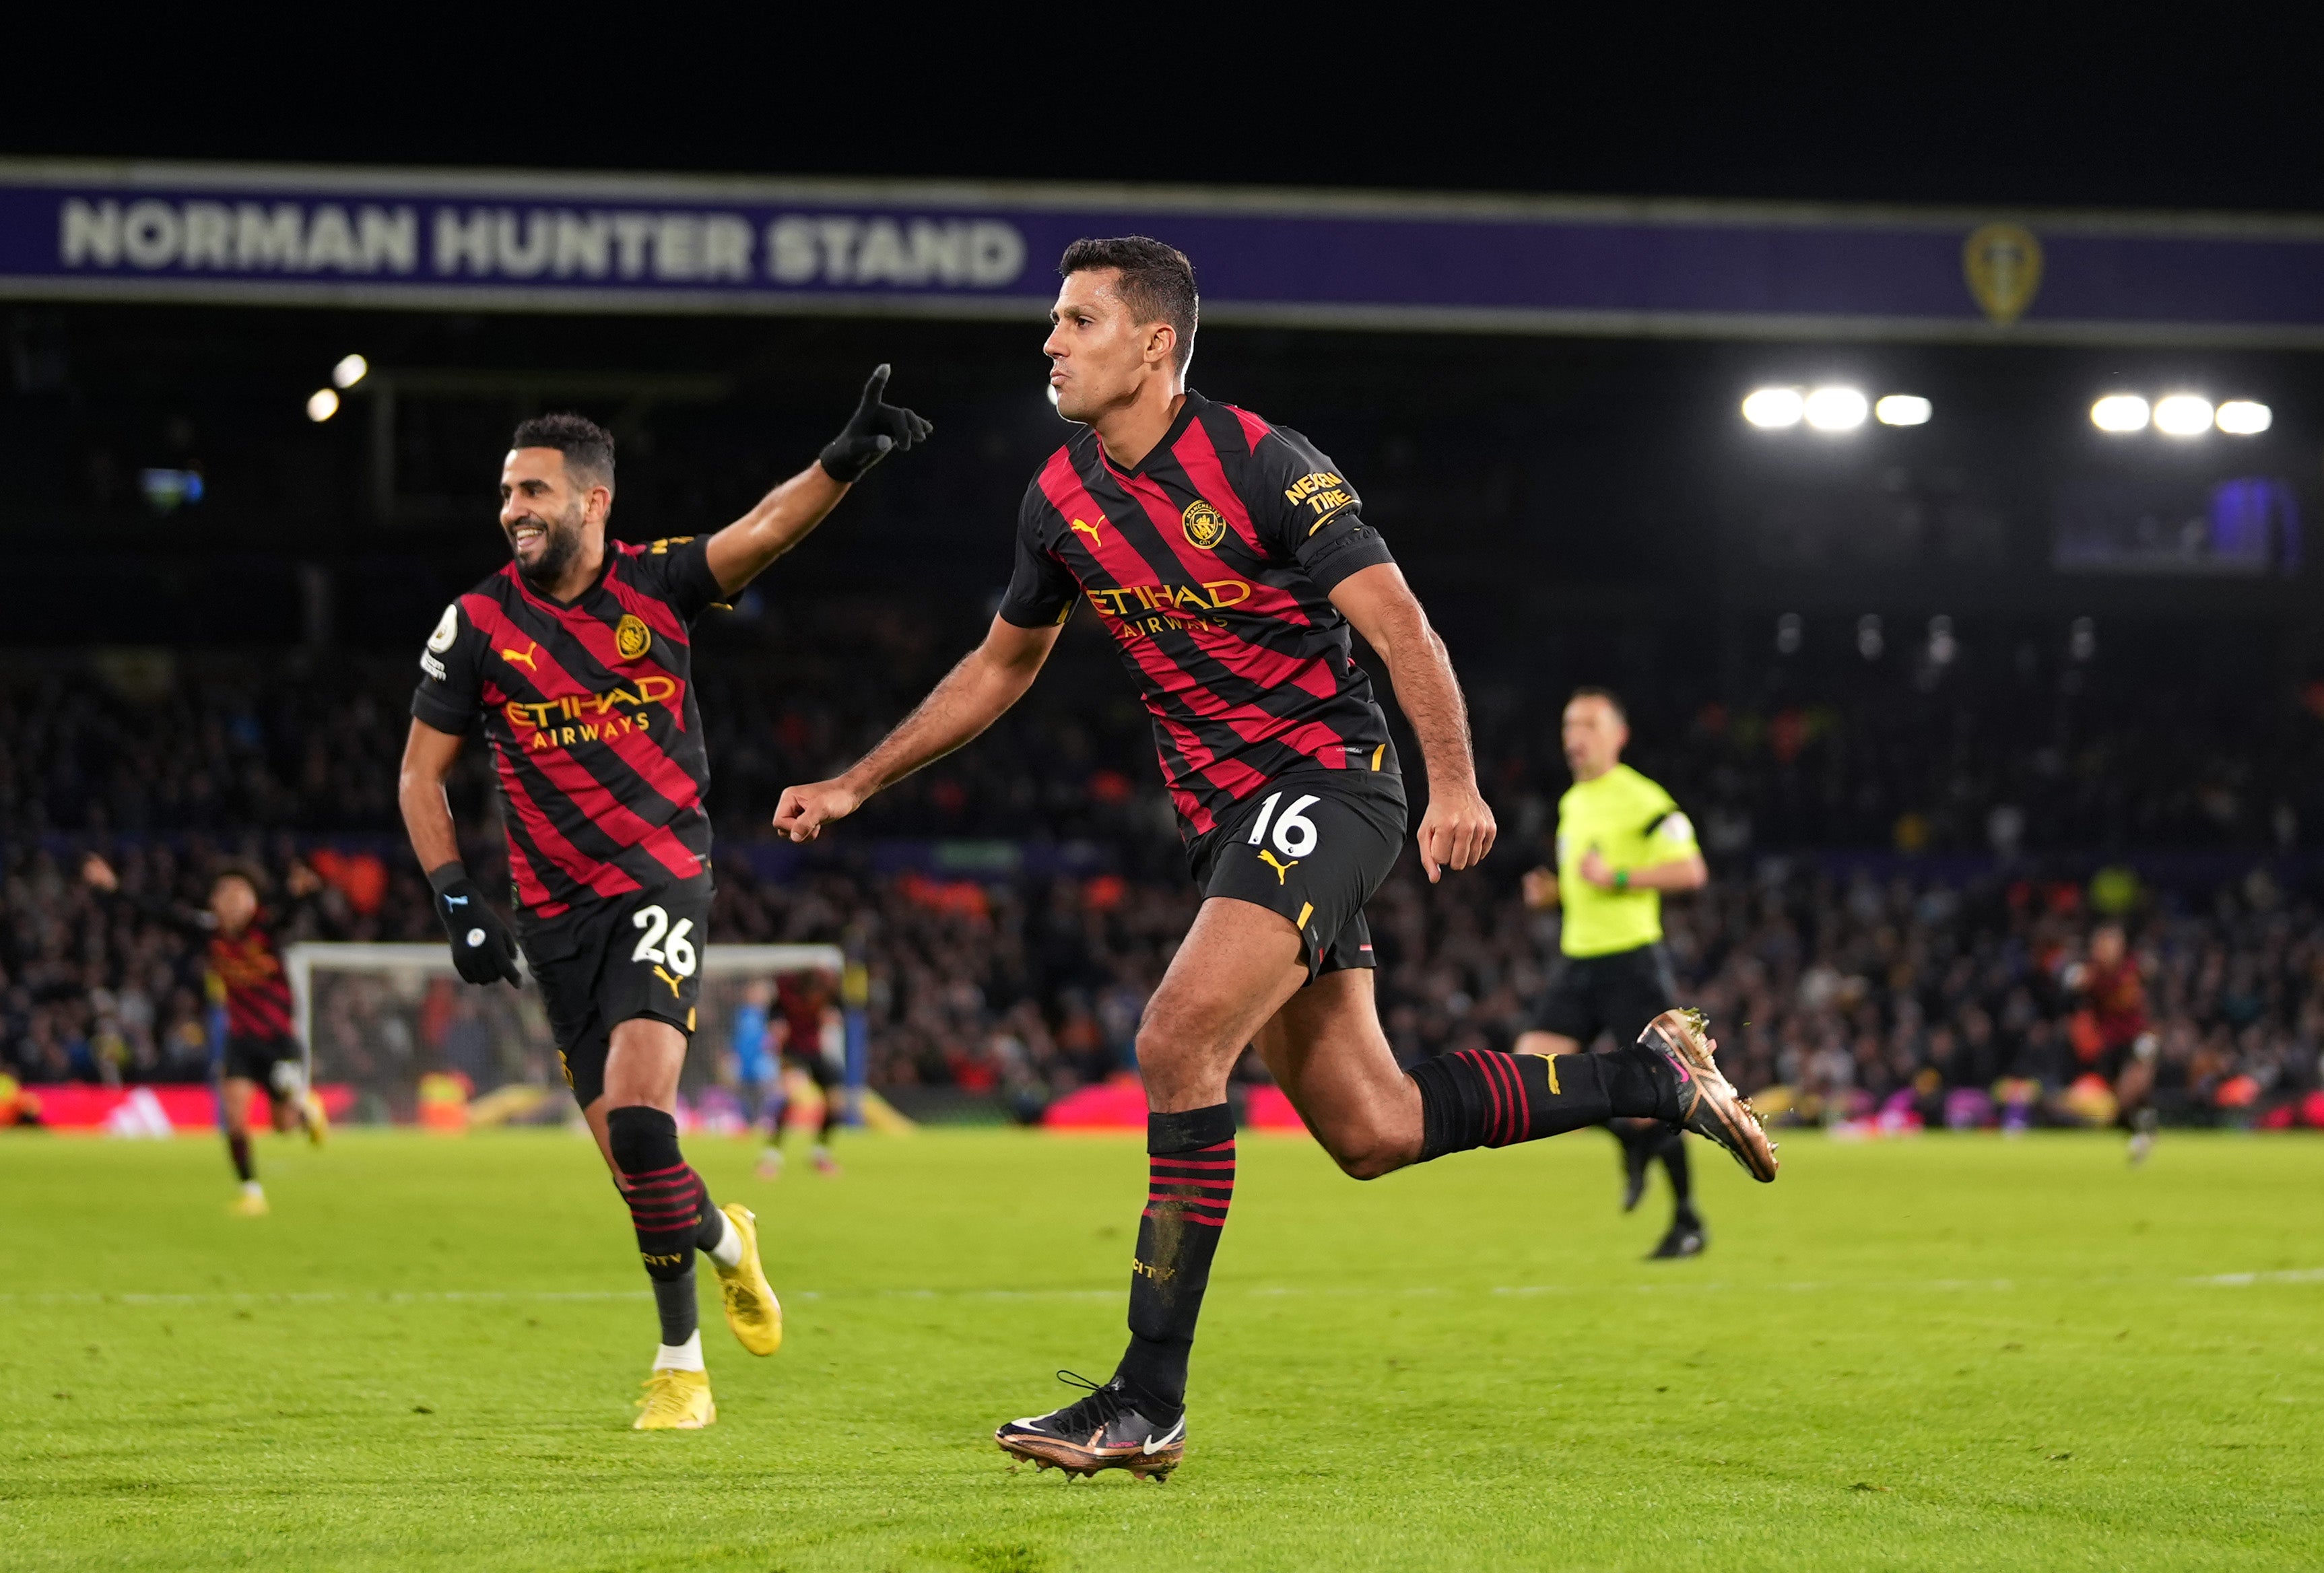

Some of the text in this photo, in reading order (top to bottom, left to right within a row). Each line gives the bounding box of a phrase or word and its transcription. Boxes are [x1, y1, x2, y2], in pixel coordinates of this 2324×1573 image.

[61, 198, 1026, 288] NORMAN HUNTER STAND
[1285, 472, 1343, 506] NEXEN
[1306, 489, 1352, 514] TIRE
[1086, 580, 1251, 615] ETIHAD
[1123, 616, 1228, 638] AIRWAYS
[507, 675, 675, 728] ETIHAD
[533, 712, 650, 749] AIRWAYS
[1247, 791, 1321, 858] 16
[631, 904, 697, 976] 26
